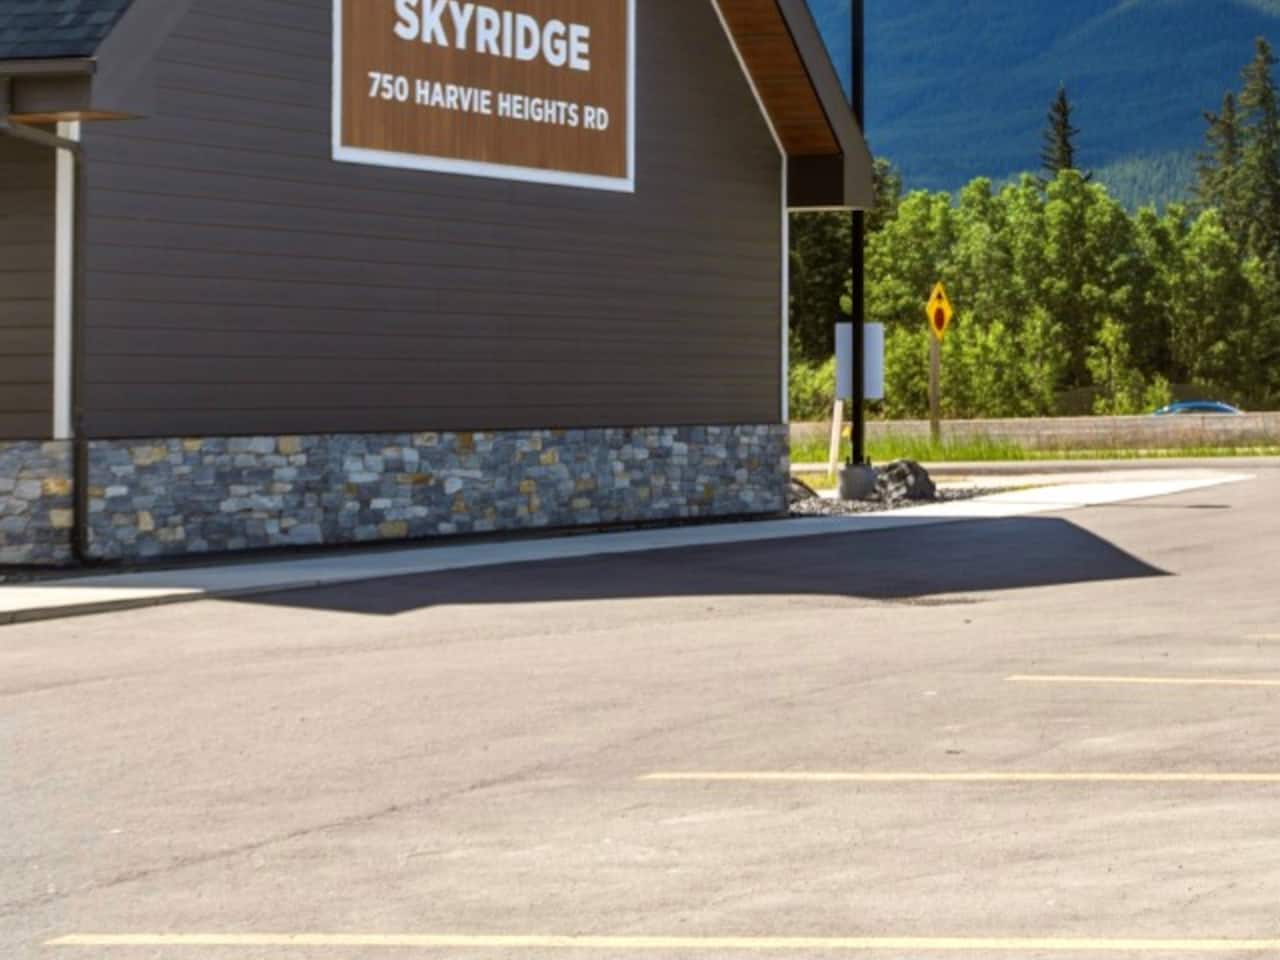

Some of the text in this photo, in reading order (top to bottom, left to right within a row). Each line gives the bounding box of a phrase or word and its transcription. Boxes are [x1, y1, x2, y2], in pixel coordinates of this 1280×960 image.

[367, 72, 609, 130] 750 HARVIE HEIGHTS RD
